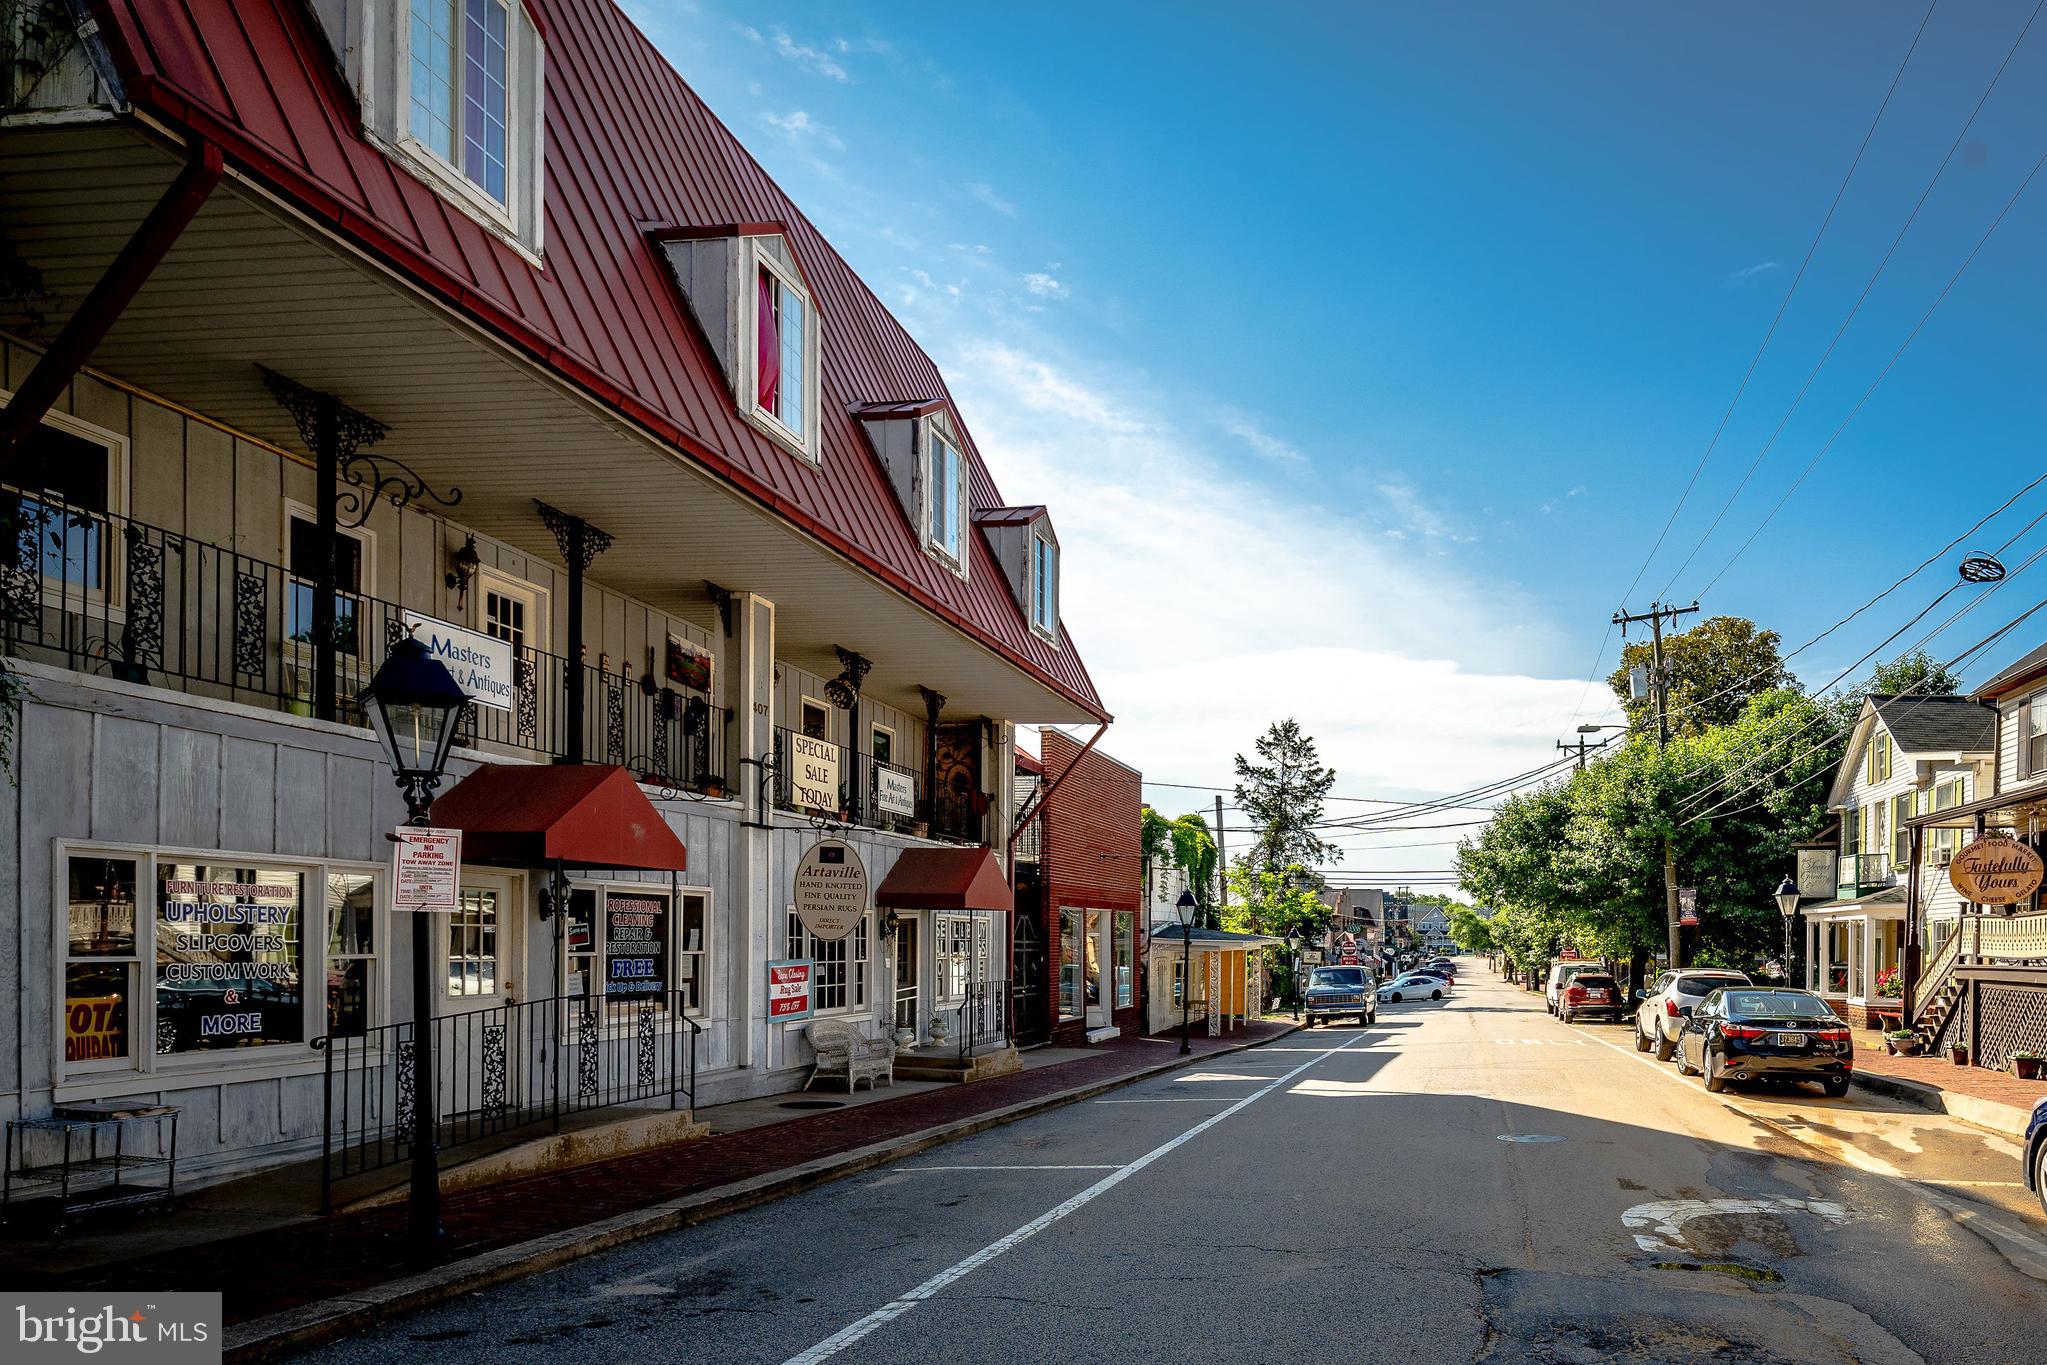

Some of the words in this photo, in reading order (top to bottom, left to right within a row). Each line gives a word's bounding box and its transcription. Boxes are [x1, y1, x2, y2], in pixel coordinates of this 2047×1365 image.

[431, 634, 491, 669] Masters
[459, 669, 465, 685] &
[466, 669, 510, 698] Antiques
[796, 737, 836, 763] SPECIAL
[805, 764, 829, 784] SALE
[800, 787, 834, 809] TODAY
[409, 836, 449, 844] EMERGENCY
[423, 844, 434, 852] NO
[412, 851, 444, 860] PARKING
[1955, 843, 1985, 865] GOURMET
[2012, 843, 2037, 863] MARKET
[801, 865, 861, 879] Artaville
[1963, 856, 2031, 875] Tastefully
[166, 880, 224, 896] FURNITURE
[227, 882, 293, 898] RESTORATION
[825, 881, 862, 890] KNOTTED
[1956, 882, 1973, 898] WINE
[1981, 895, 2006, 903] CHEESE
[2015, 879, 2038, 898] GELATO
[1974, 874, 2019, 893] Yours
[804, 891, 821, 899] FINE
[823, 892, 857, 901] QUALITY
[165, 901, 292, 925] UPHOLSTERY
[606, 898, 662, 914] ROFESSIONAL
[803, 903, 835, 911] PERSIAN
[612, 912, 654, 927] CLEANING
[613, 927, 643, 940] REPAIR
[644, 927, 653, 940] &
[177, 934, 284, 952] SLIPCOVERS
[606, 941, 661, 955] RESTORATION
[166, 962, 240, 981] CUSTOM
[243, 962, 291, 979] WORK
[611, 958, 655, 978] FREE
[788, 968, 806, 981] Closing
[606, 980, 616, 993] ick
[617, 981, 628, 994] Up
[780, 985, 791, 996] Rug
[791, 983, 801, 993] Sale
[224, 988, 240, 1005] &
[201, 1013, 262, 1035] MORE
